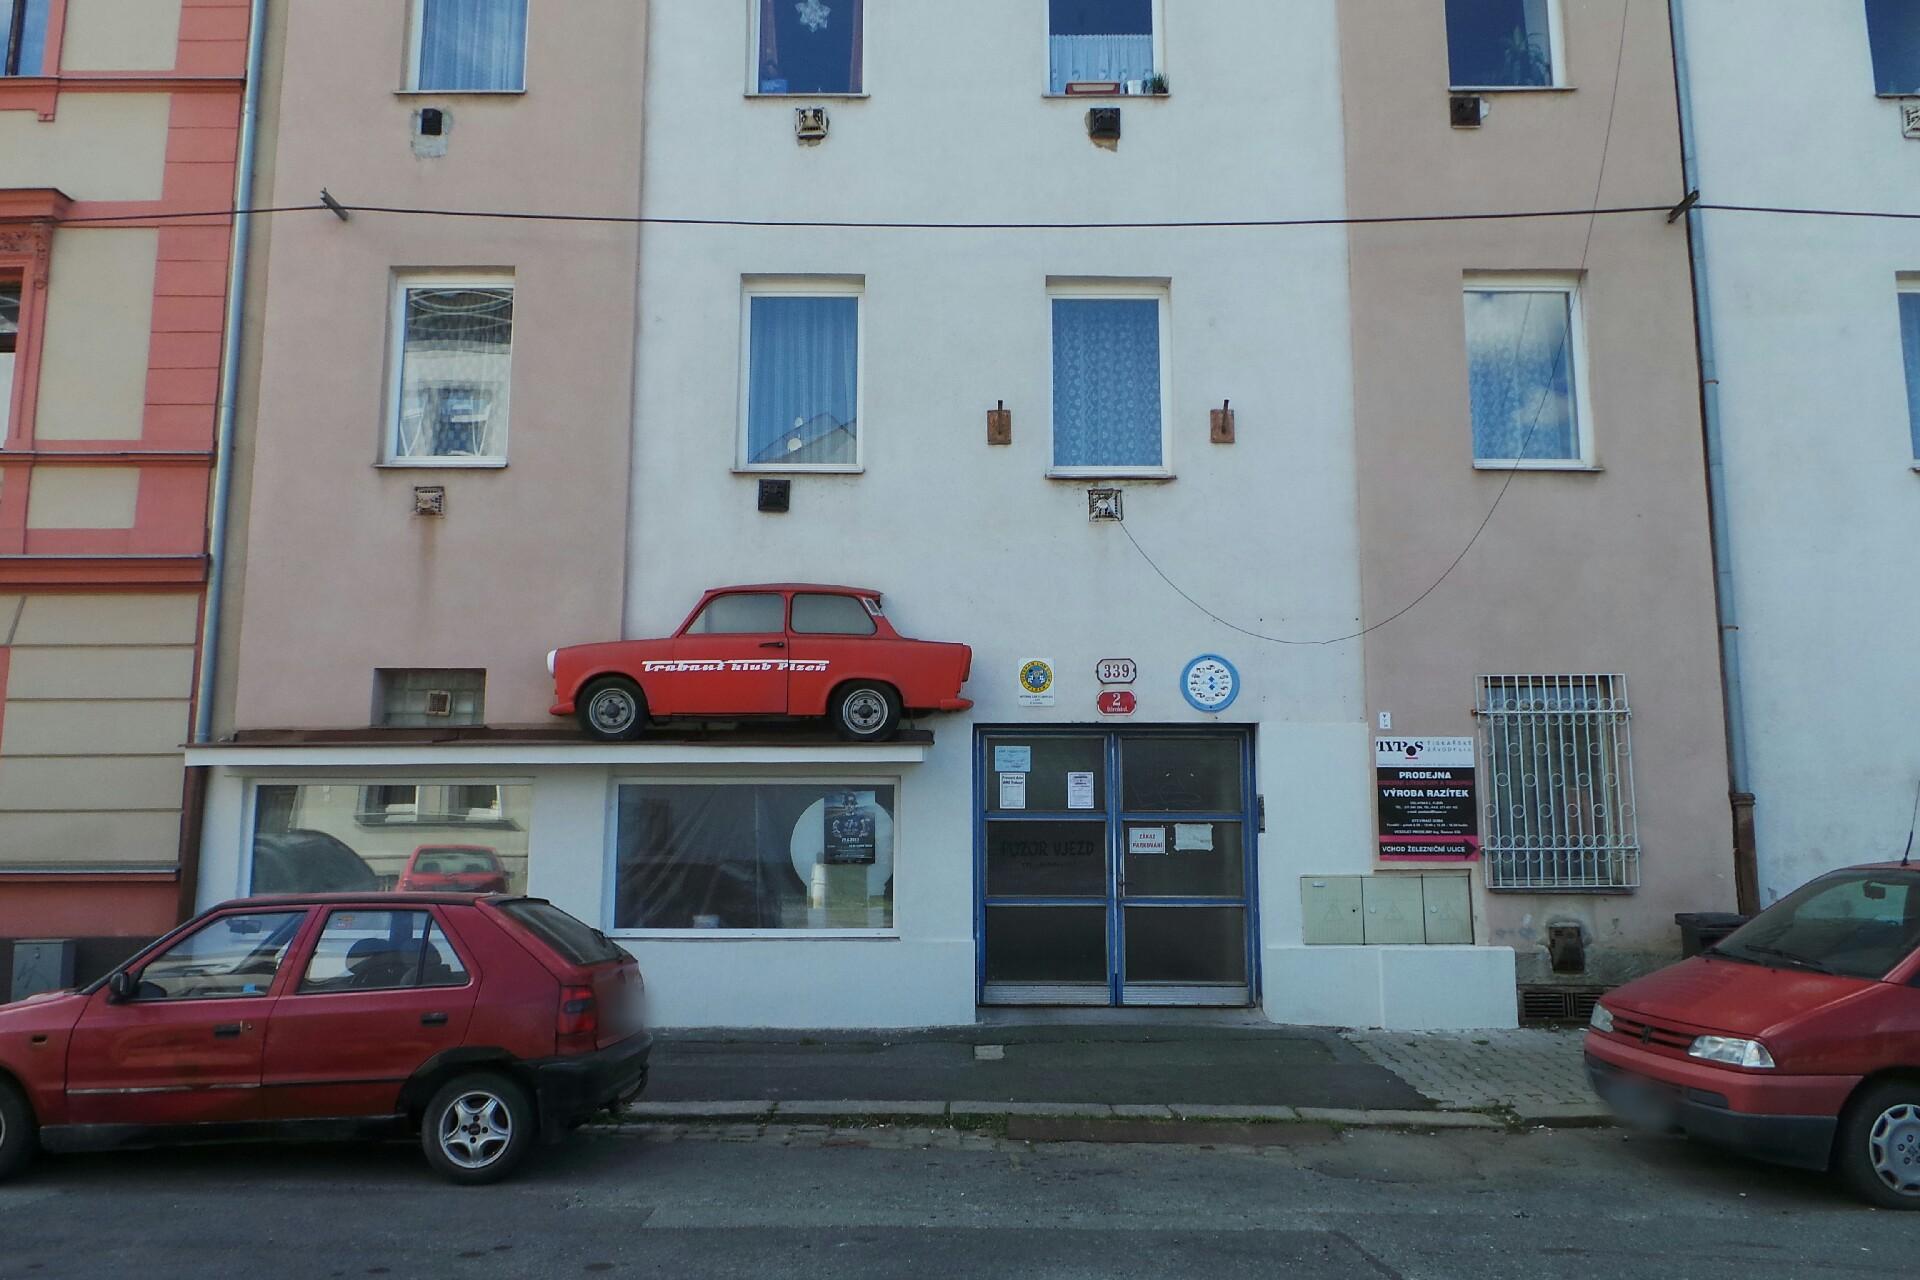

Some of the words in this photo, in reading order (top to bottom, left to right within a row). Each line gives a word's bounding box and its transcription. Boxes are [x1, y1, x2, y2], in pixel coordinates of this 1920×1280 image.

[642, 660, 725, 672] Trabant
[731, 661, 772, 671] klub
[776, 661, 828, 672] Plzeň
[1104, 664, 1130, 678] 339
[1112, 692, 1121, 706] 2
[1399, 771, 1452, 779] PRODEJNA
[1383, 787, 1424, 797] VÝROBA
[1426, 787, 1469, 797] RAZÍTEK
